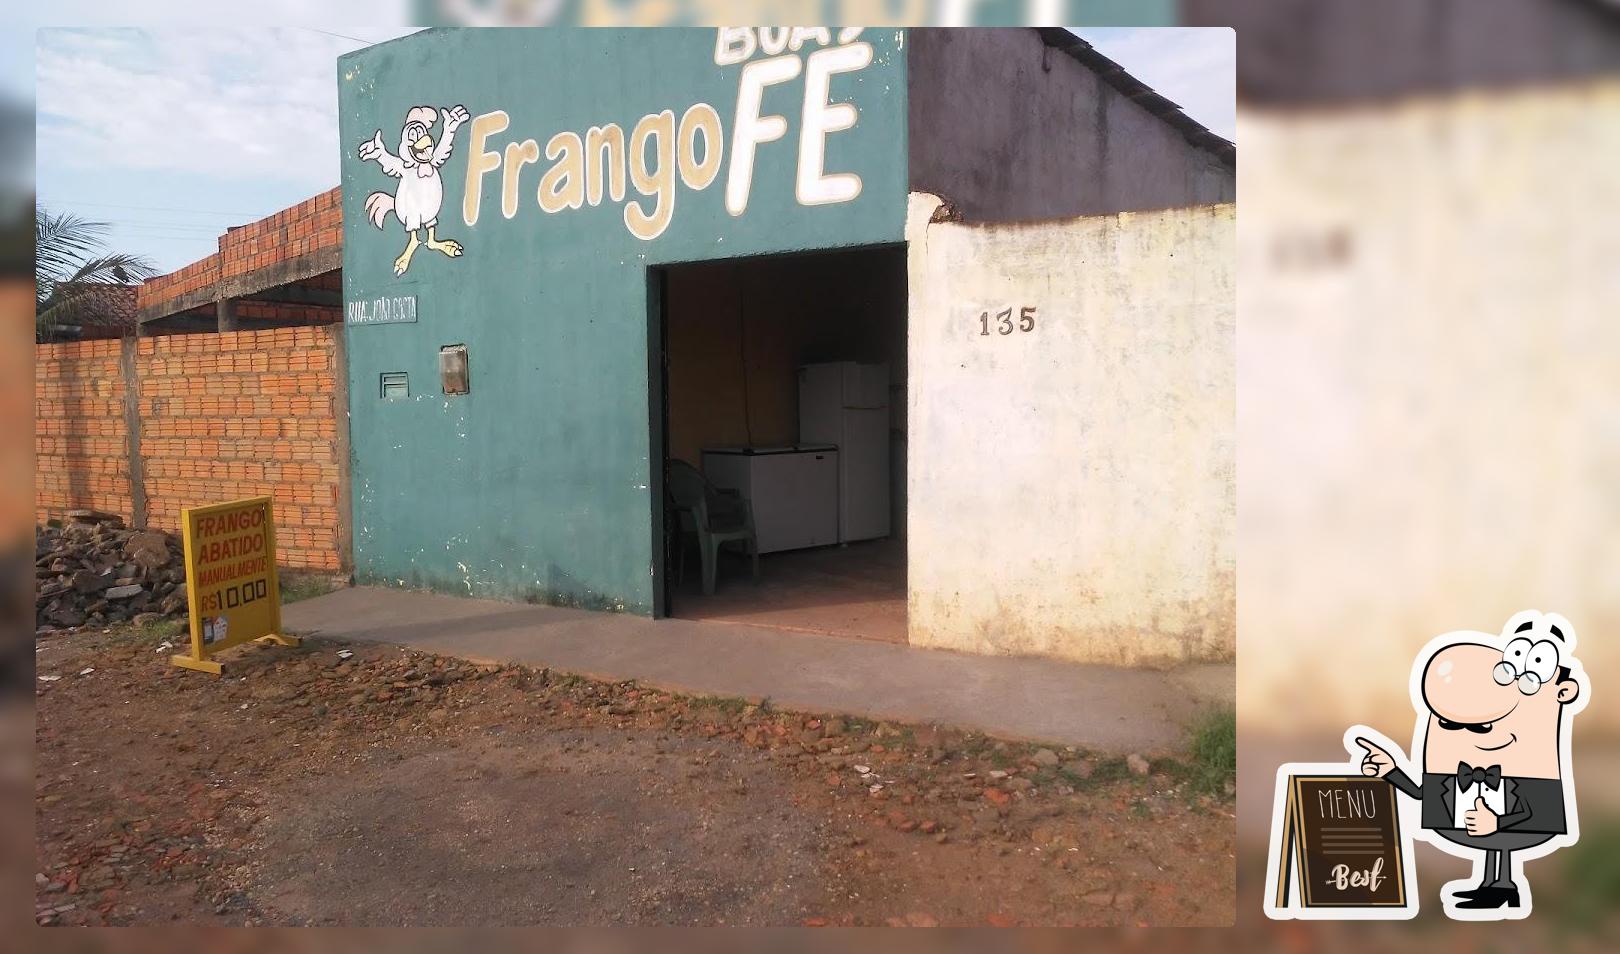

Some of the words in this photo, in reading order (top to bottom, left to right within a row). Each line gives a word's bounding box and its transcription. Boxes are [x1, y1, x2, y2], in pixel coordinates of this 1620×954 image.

[463, 103, 723, 241] Frango
[980, 306, 1037, 336] 135
[196, 507, 263, 539] FRANGO
[198, 533, 264, 566] ABATIDO
[199, 556, 268, 587] MANUALMENTE
